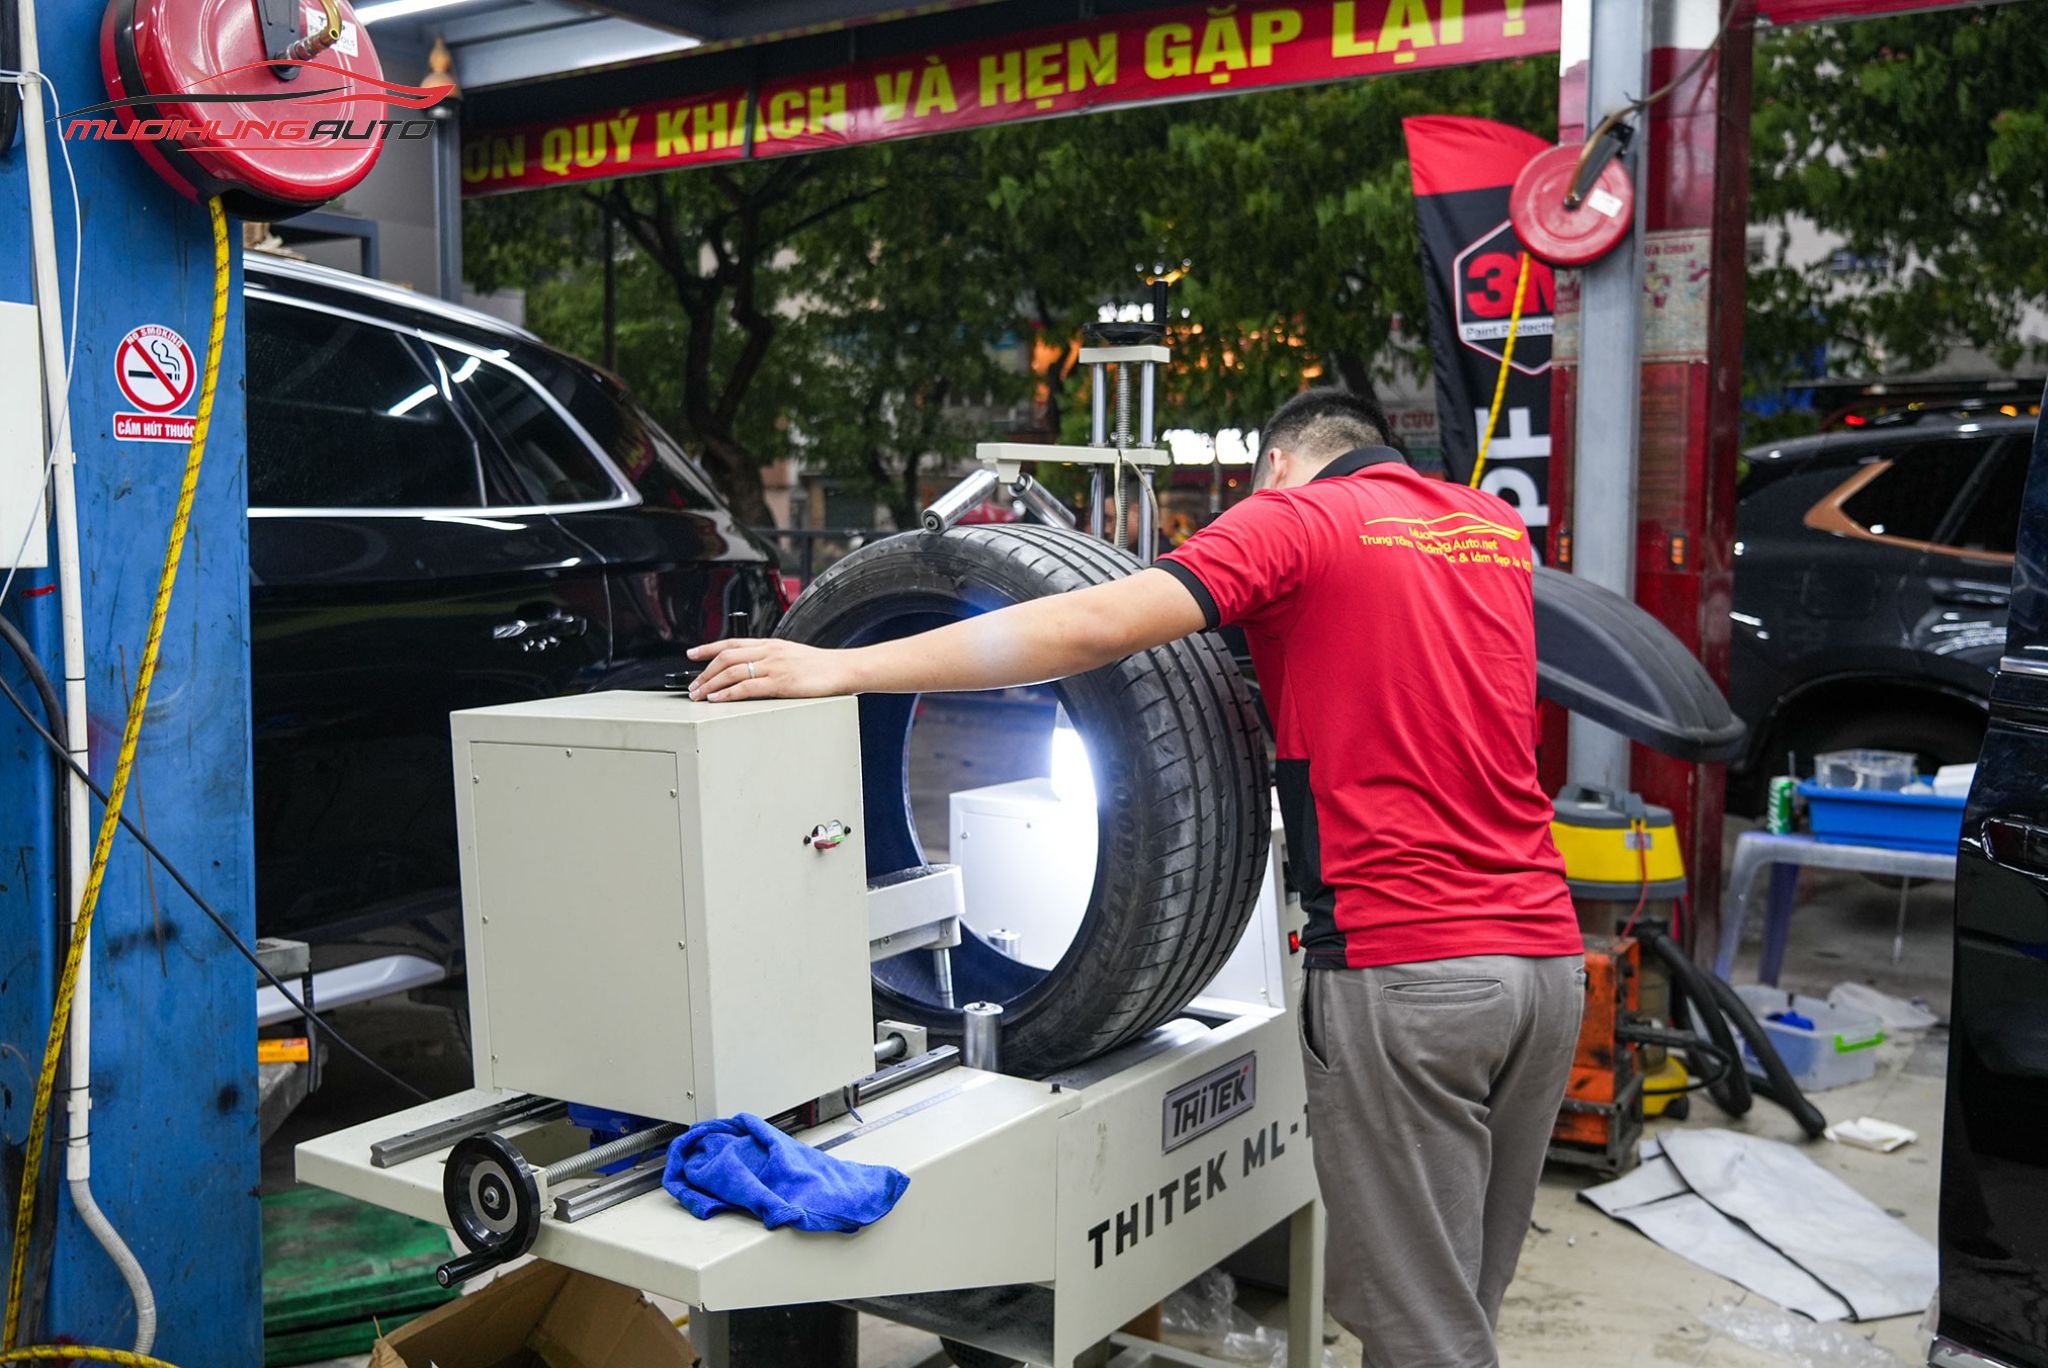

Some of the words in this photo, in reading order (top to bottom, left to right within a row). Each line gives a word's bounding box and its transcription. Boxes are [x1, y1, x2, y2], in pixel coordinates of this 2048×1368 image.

[542, 108, 639, 176] QUÝ
[875, 54, 958, 120] VÀ
[979, 32, 1118, 109] HẸN
[1144, 4, 1303, 85] GẶP
[1331, 0, 1464, 64] LẠI
[126, 332, 139, 345] NO
[140, 327, 183, 349] SMOKING
[1466, 326, 1498, 337] Paint
[117, 418, 142, 436] CẤM
[143, 421, 163, 437] HÚT
[1359, 535, 1393, 547] Trung
[1459, 551, 1469, 563] &
[1088, 1150, 1227, 1269] THITEK
